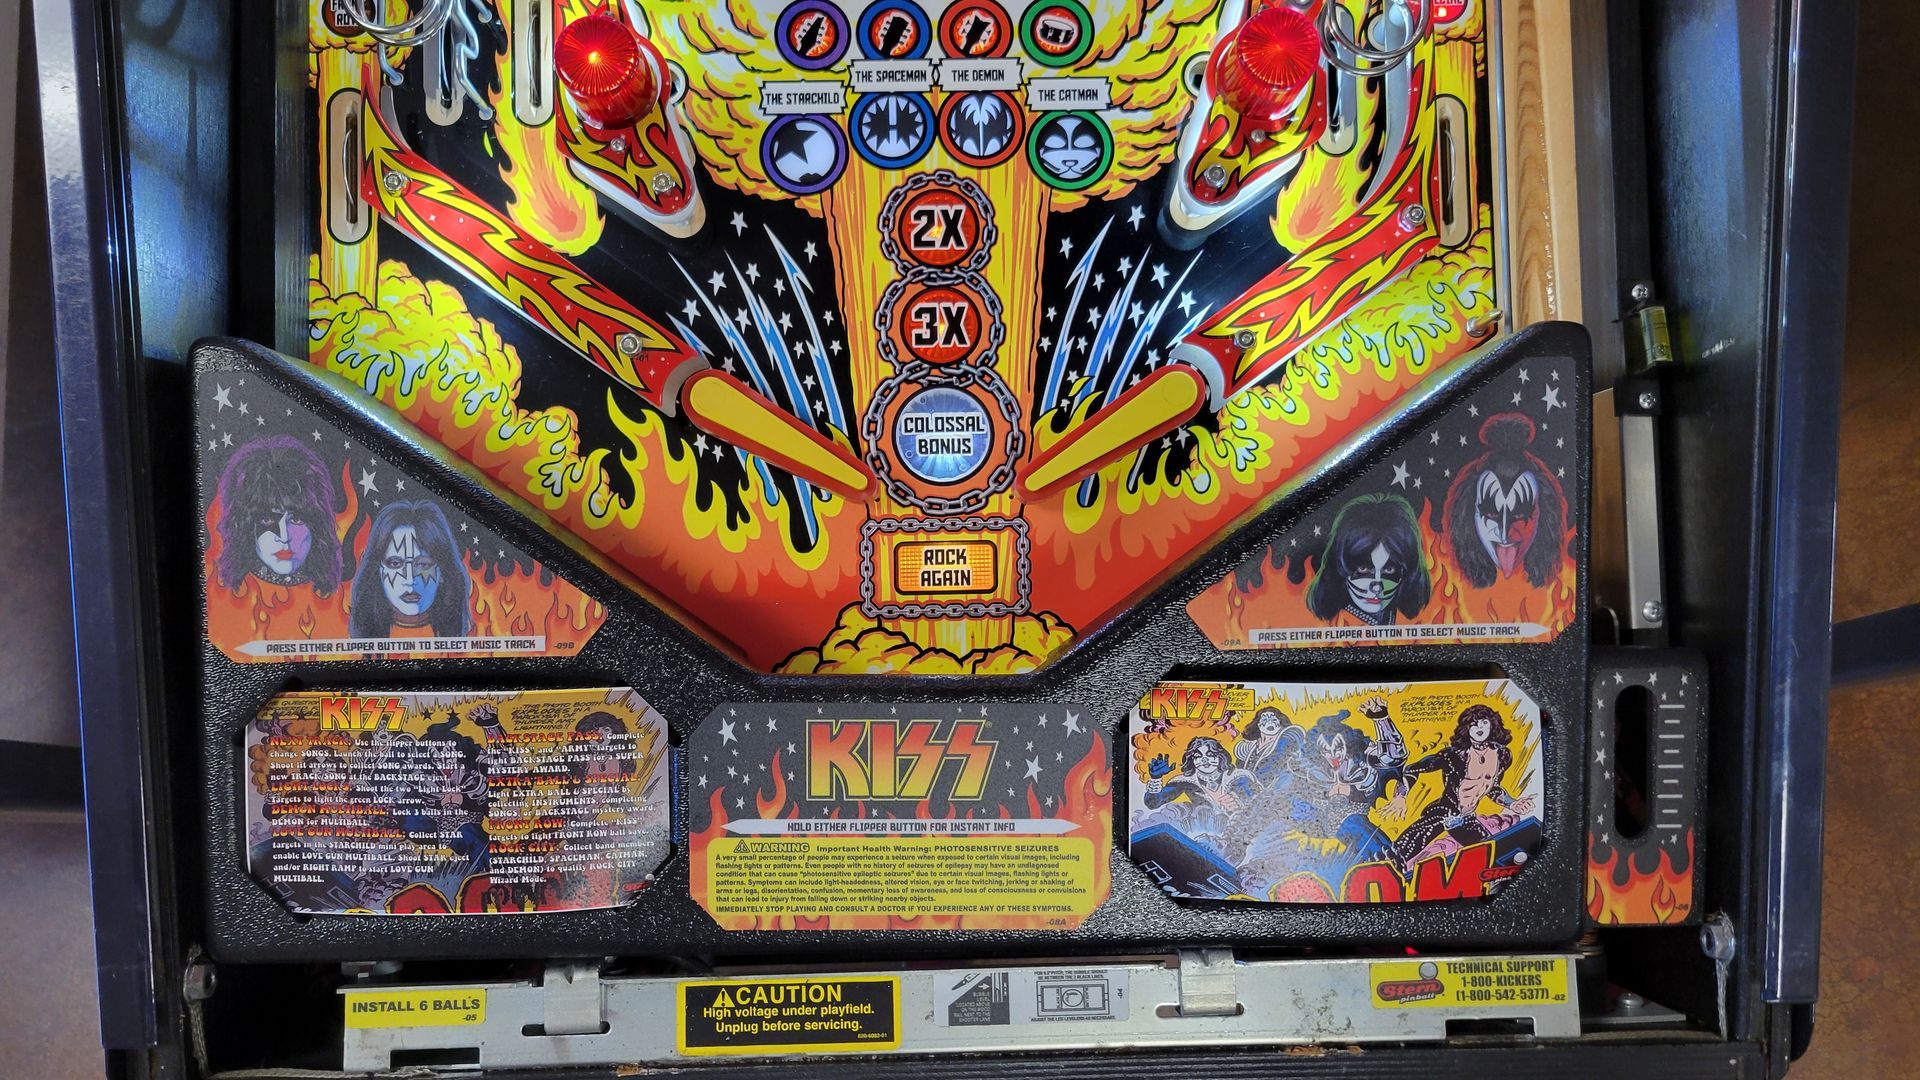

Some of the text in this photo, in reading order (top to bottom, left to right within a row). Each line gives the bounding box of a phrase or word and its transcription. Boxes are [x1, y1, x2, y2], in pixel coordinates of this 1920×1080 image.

[856, 70, 927, 83] THE SPACEMAN
[952, 70, 1005, 82] THE DEMON
[765, 92, 840, 105] THE STARCHILD
[1038, 89, 1098, 101] THE CATMAN
[912, 205, 967, 250] 2X
[913, 303, 969, 347] 3X
[903, 416, 985, 433] COLOSSAL
[918, 438, 972, 454] BONUS
[923, 549, 967, 565] ROCK
[920, 570, 971, 587] AGAIN
[1258, 626, 1520, 642] PRESS EITHER FLIPPER BUTTON TO SELECT MUSIC TRACK
[266, 639, 536, 653] PRESS EITHER FLIPPER BUTTON TO SELECT MUSIC TRACK
[1151, 688, 1230, 720] KISS
[320, 697, 409, 731] KISS
[487, 732, 564, 743] BACKSTAGE
[806, 720, 999, 801] KISS
[487, 766, 529, 774] MYSTERY
[488, 776, 532, 787] EXTRA
[536, 776, 570, 785] BALL
[272, 804, 316, 814] DEMON
[488, 819, 530, 830] FRONT
[788, 822, 1016, 832] HOLD EITHER FLIPPER BUTTON FOR INSTANT INFO
[488, 843, 524, 853] ROCK
[750, 842, 810, 853] WARNING
[816, 846, 860, 854] Important
[894, 845, 931, 854] Warning:
[807, 854, 830, 862] people
[847, 854, 884, 862] experience
[331, 864, 356, 872] RAMP
[490, 876, 518, 884] Wizard
[1446, 960, 1555, 974] TECHNICAL SUPPORT
[1462, 975, 1542, 988] 1-800-KICKERS
[736, 984, 842, 1006] CAUTION
[1383, 982, 1438, 998] Stern
[1456, 988, 1550, 1002] (1-800-542-5377)
[1400, 992, 1435, 1003] pinball
[352, 998, 481, 1013] INSTALL 6 BALLS
[703, 1002, 875, 1019] High voltage under playfield.
[462, 1014, 478, 1022] -05
[716, 1019, 863, 1034] Unplug before servicing.
